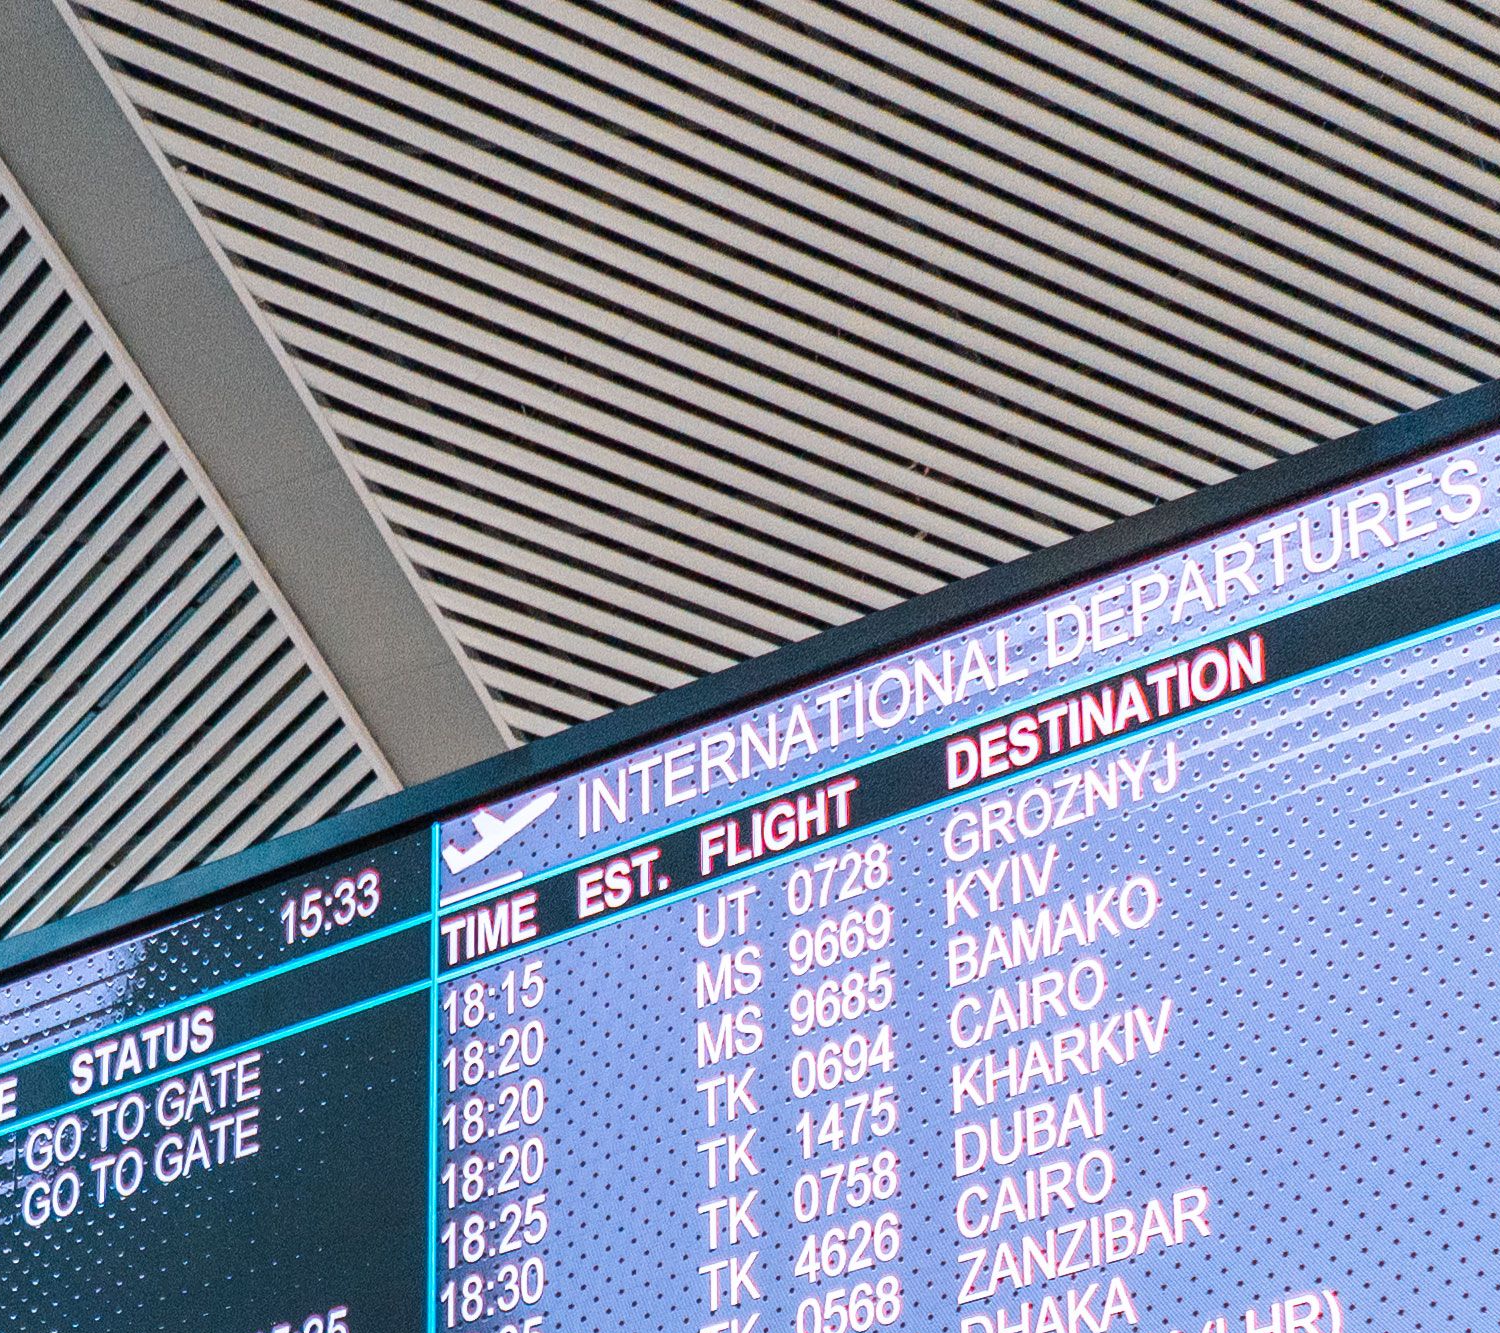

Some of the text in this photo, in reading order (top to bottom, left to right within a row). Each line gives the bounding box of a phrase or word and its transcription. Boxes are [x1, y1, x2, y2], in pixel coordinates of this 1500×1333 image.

[576, 456, 1488, 838] INTERNATIONAL DEPARTURES
[439, 890, 538, 965] TIME
[578, 846, 670, 919] EST.
[700, 778, 858, 876] FLIGHT
[945, 633, 1265, 790] DESTINATION
[279, 869, 381, 945] 15:33
[442, 1017, 547, 1092] 18:20
[694, 941, 764, 1009] MS
[786, 897, 895, 977] 9669
[942, 840, 1061, 929] KYIV
[68, 1006, 215, 1096] STATUS
[20, 1166, 85, 1231] GO
[88, 1145, 150, 1205] TO
[152, 1105, 261, 1186] GATE
